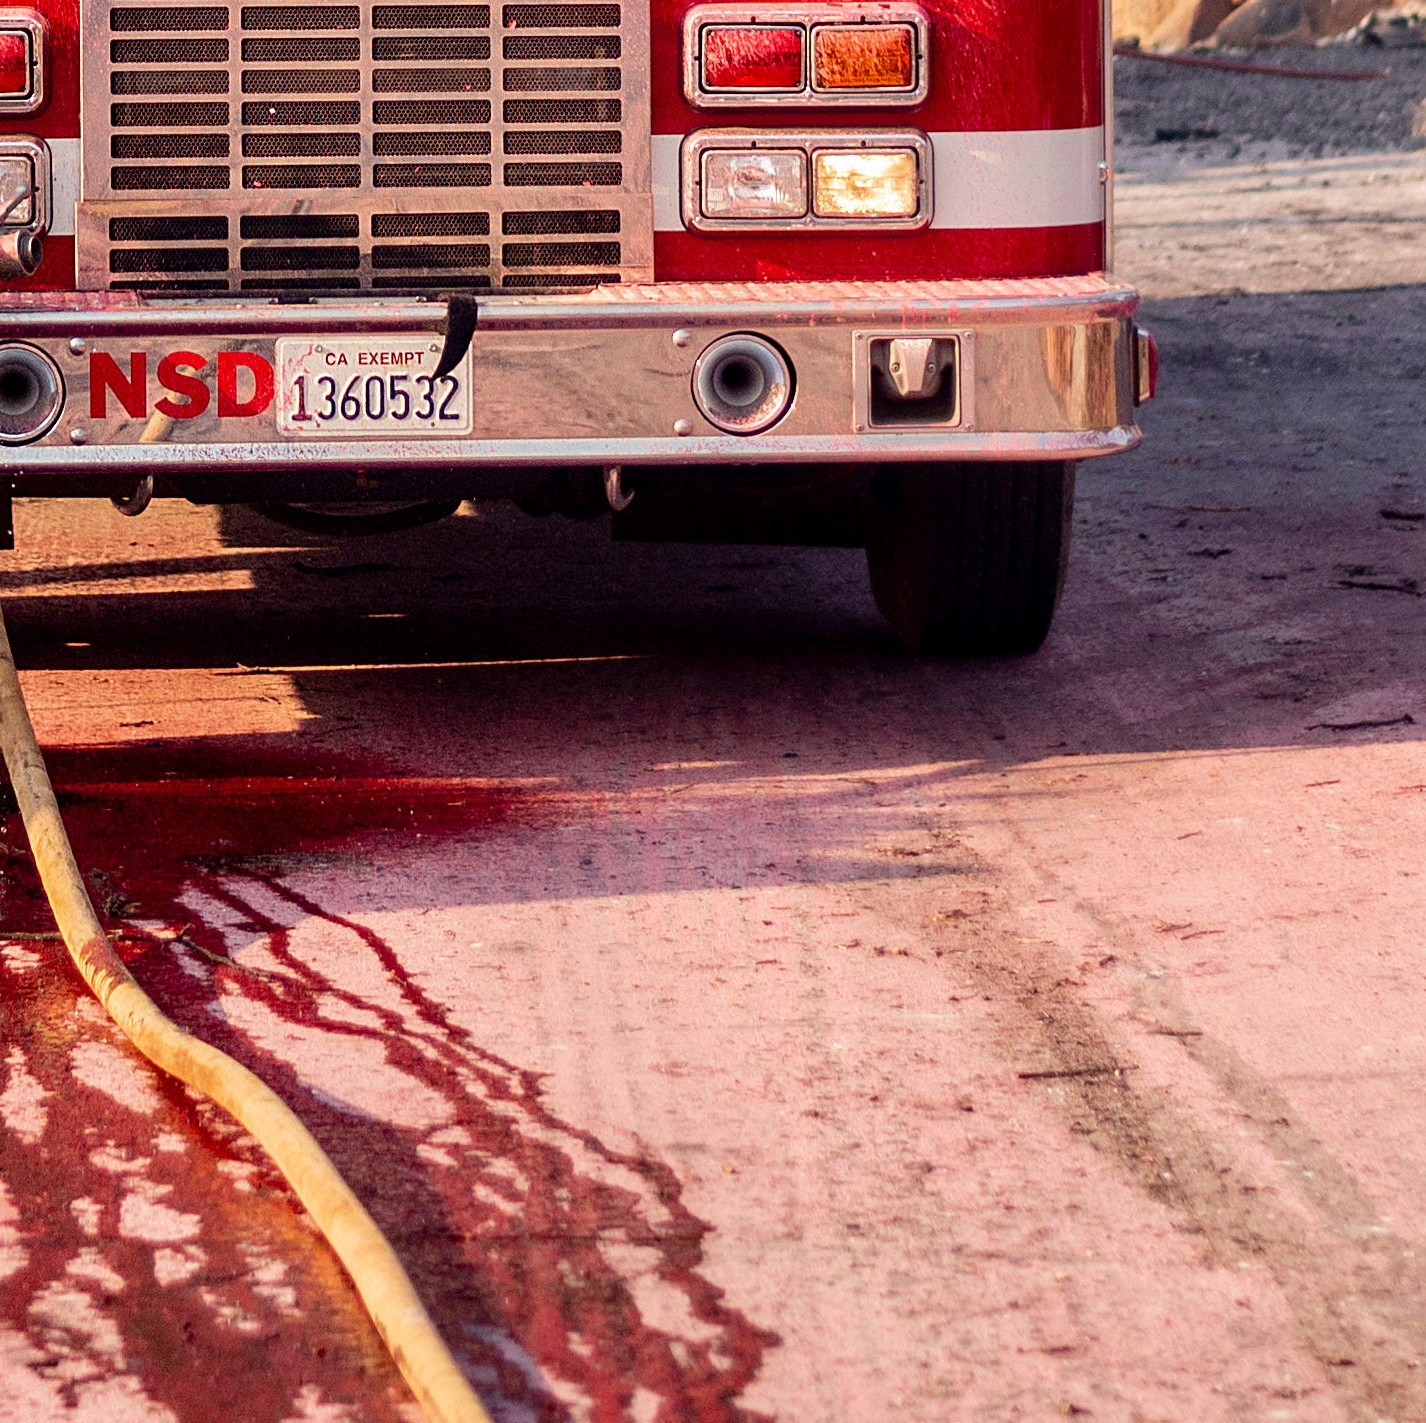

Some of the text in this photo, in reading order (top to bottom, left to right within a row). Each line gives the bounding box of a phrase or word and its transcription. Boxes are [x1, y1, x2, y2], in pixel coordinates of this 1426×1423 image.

[325, 352, 425, 366] CA EXEMPT
[89, 350, 275, 419] NSD
[291, 375, 460, 421] 1360532
